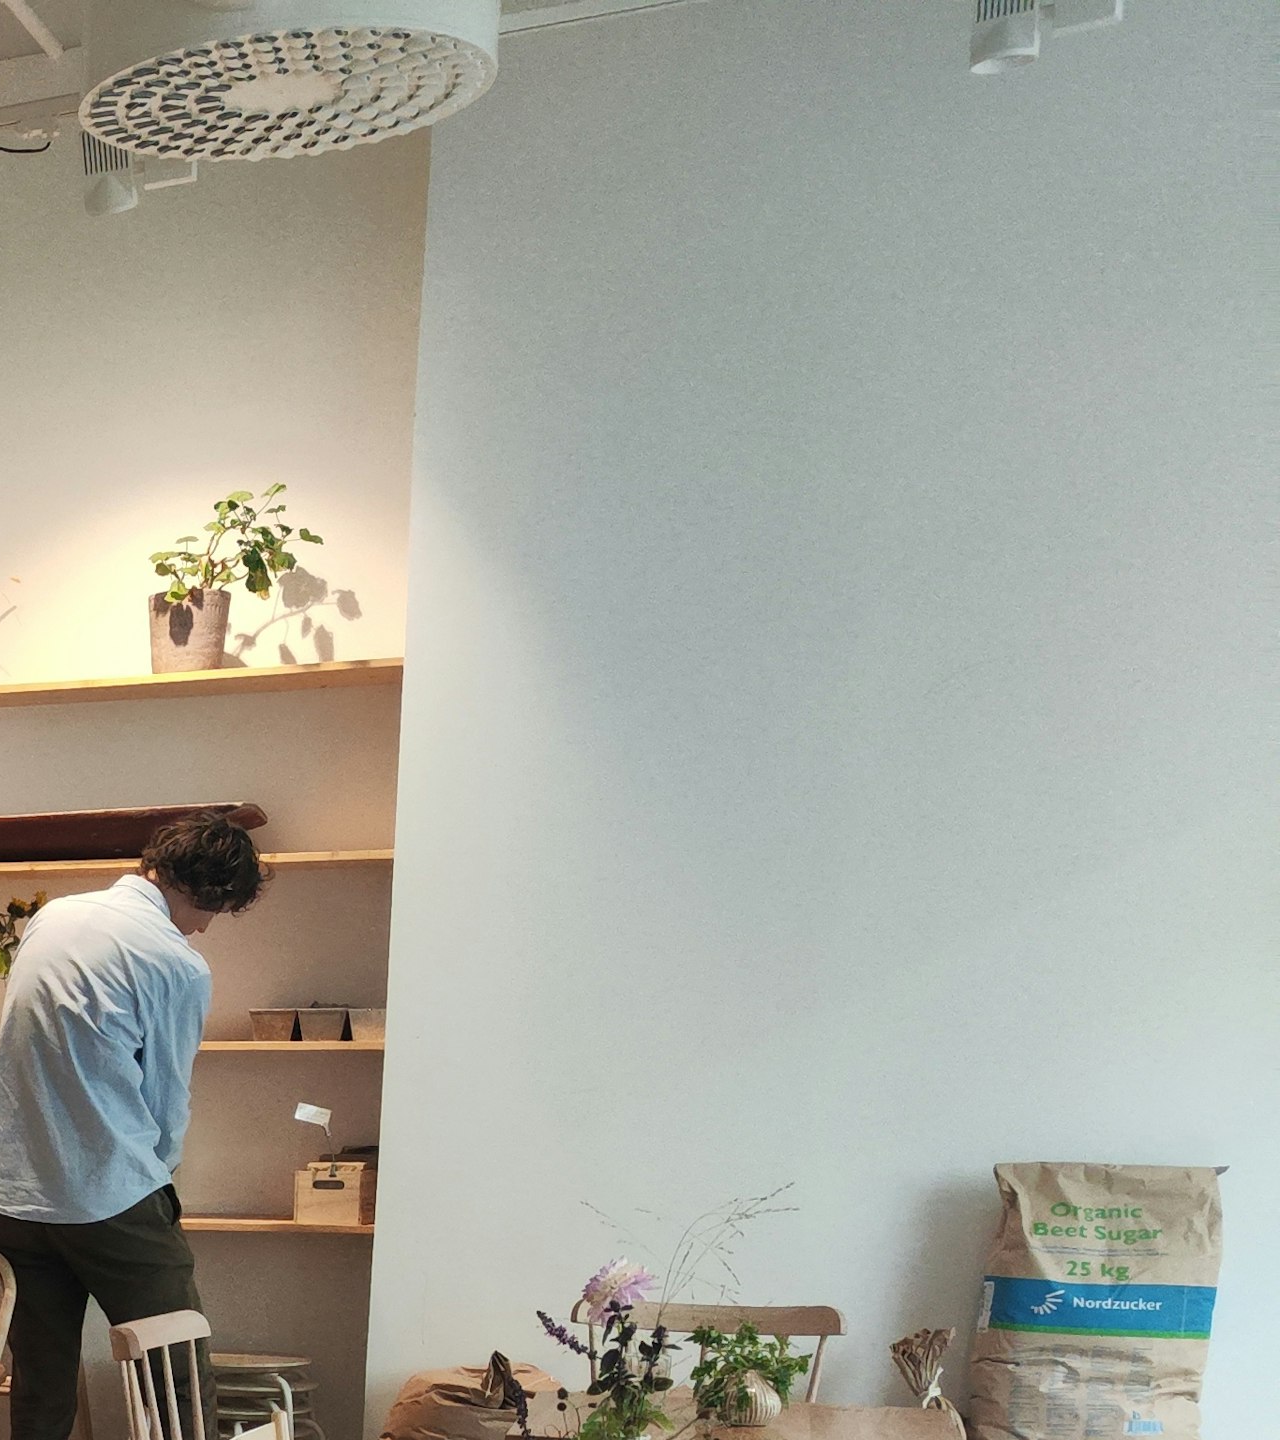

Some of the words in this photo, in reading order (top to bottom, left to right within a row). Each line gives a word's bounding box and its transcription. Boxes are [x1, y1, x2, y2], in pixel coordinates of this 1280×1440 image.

[1050, 1202, 1142, 1222] Organic
[1033, 1222, 1088, 1238] Beet
[1094, 1225, 1162, 1245] Sugar
[1066, 1260, 1091, 1276] 25
[1100, 1263, 1130, 1281] kg
[1073, 1296, 1162, 1312] Nordzucker
